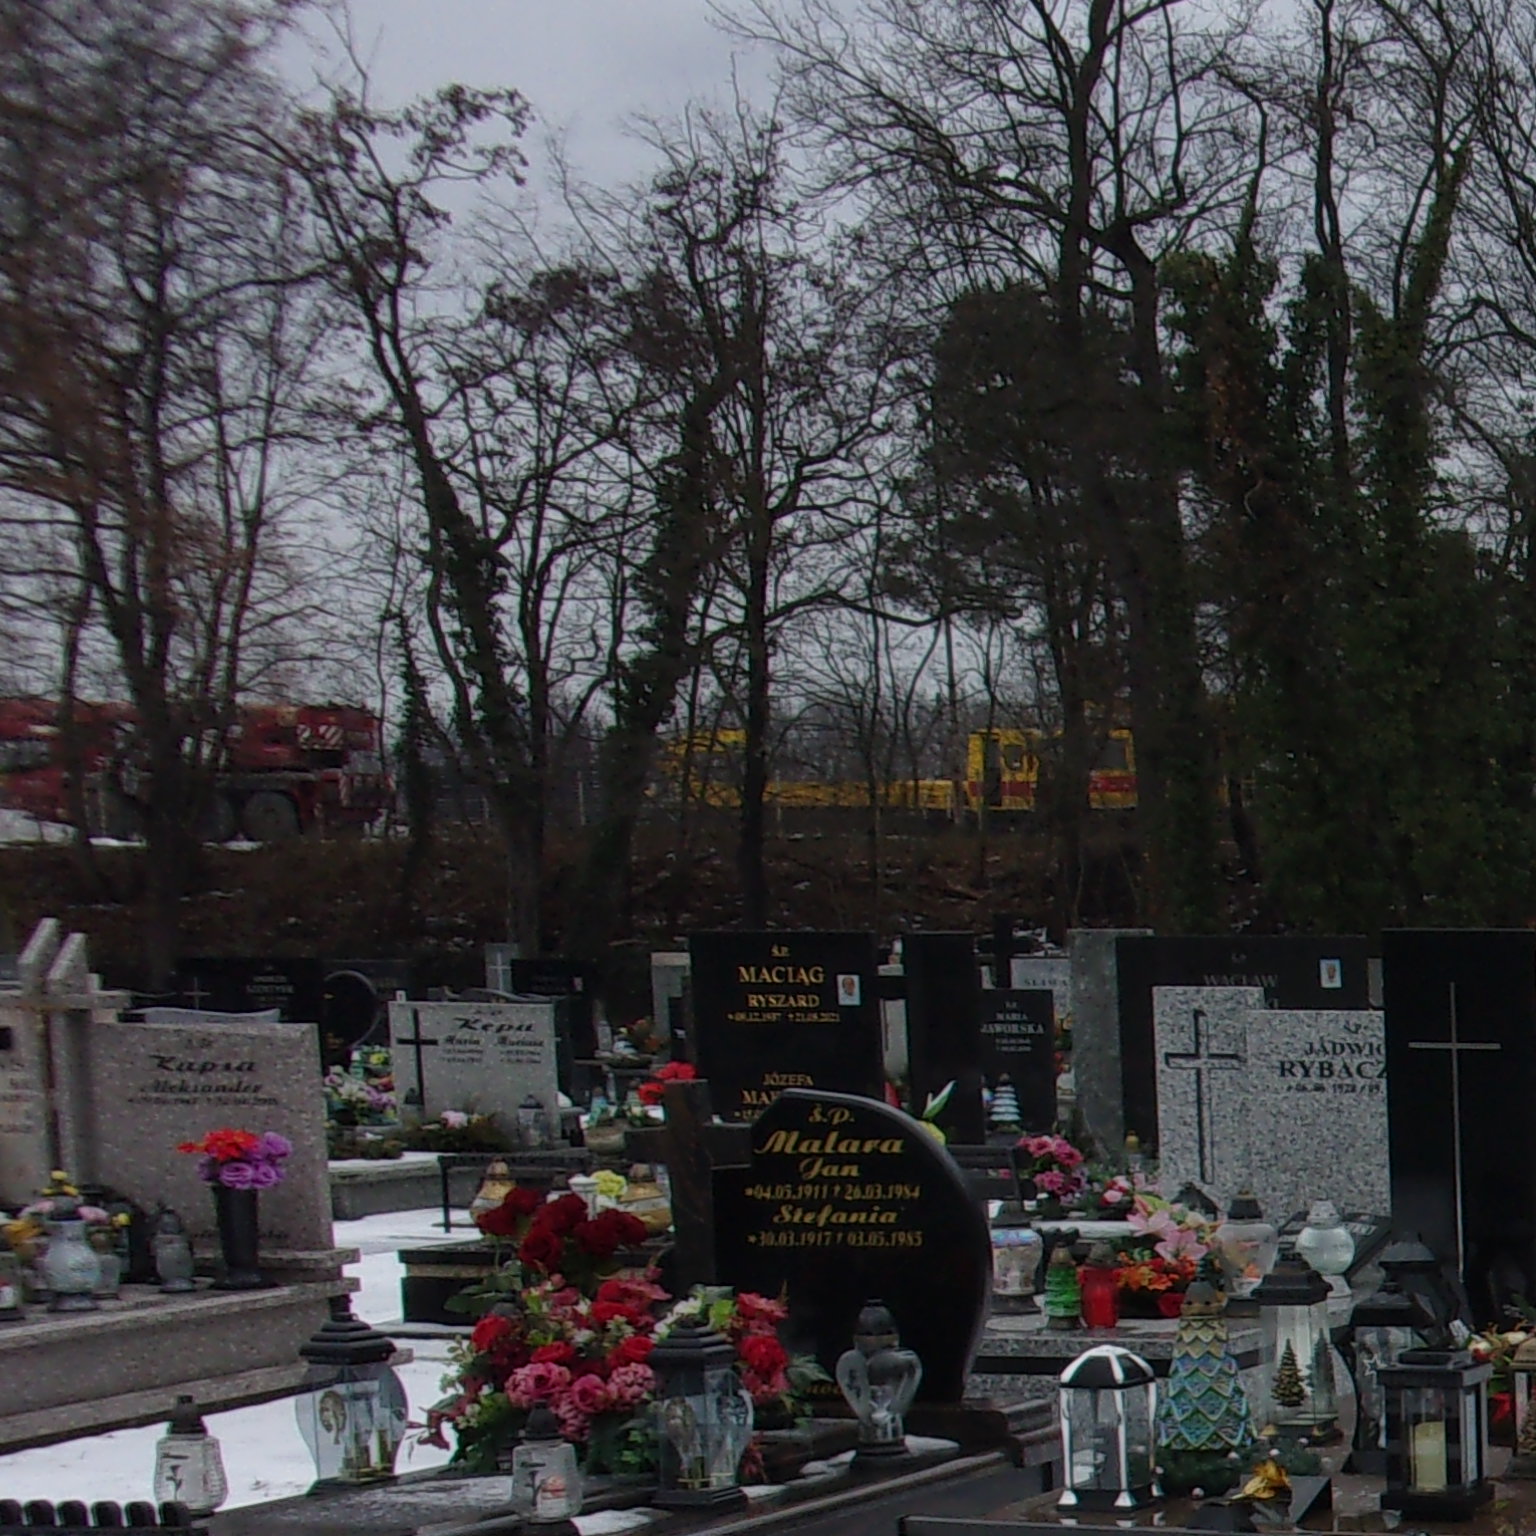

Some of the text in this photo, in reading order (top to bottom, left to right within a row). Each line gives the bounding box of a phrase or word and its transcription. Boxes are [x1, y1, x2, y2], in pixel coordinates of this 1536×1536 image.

[739, 966, 824, 986] MACIĄG
[748, 994, 820, 1008] RYSZARD
[754, 1130, 905, 1154] Malara
[800, 1157, 861, 1180] Jan
[773, 1204, 898, 1227] Stefania
